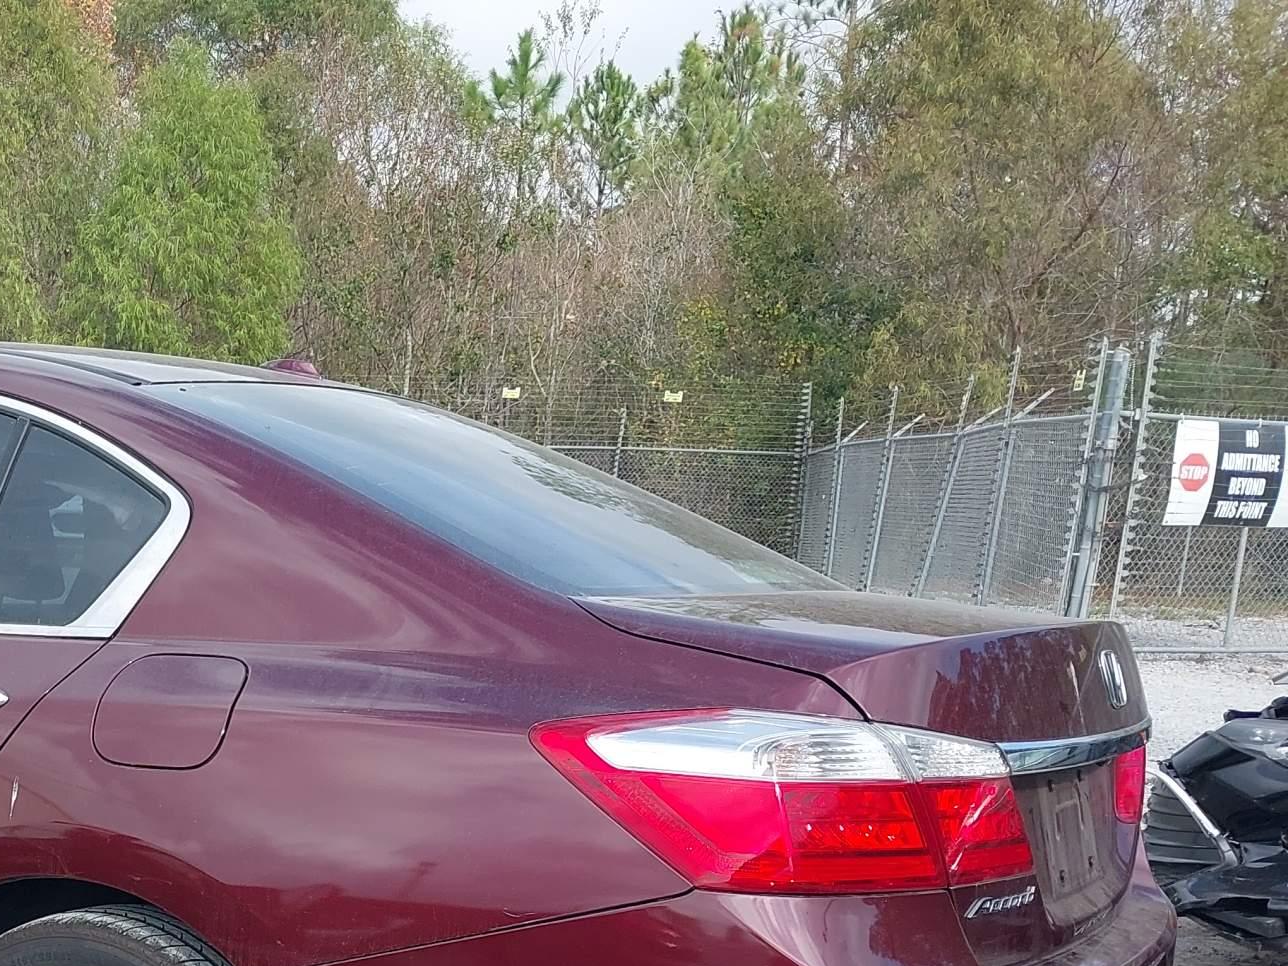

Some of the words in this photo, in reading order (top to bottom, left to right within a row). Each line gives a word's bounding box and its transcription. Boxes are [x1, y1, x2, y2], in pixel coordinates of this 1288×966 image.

[1245, 429, 1260, 448] NO
[1220, 452, 1281, 473] ADMITTANCE
[1180, 465, 1209, 480] STOP
[1227, 477, 1267, 496] BEYOND
[1213, 500, 1238, 518] THIS
[1235, 501, 1268, 519] POINT
